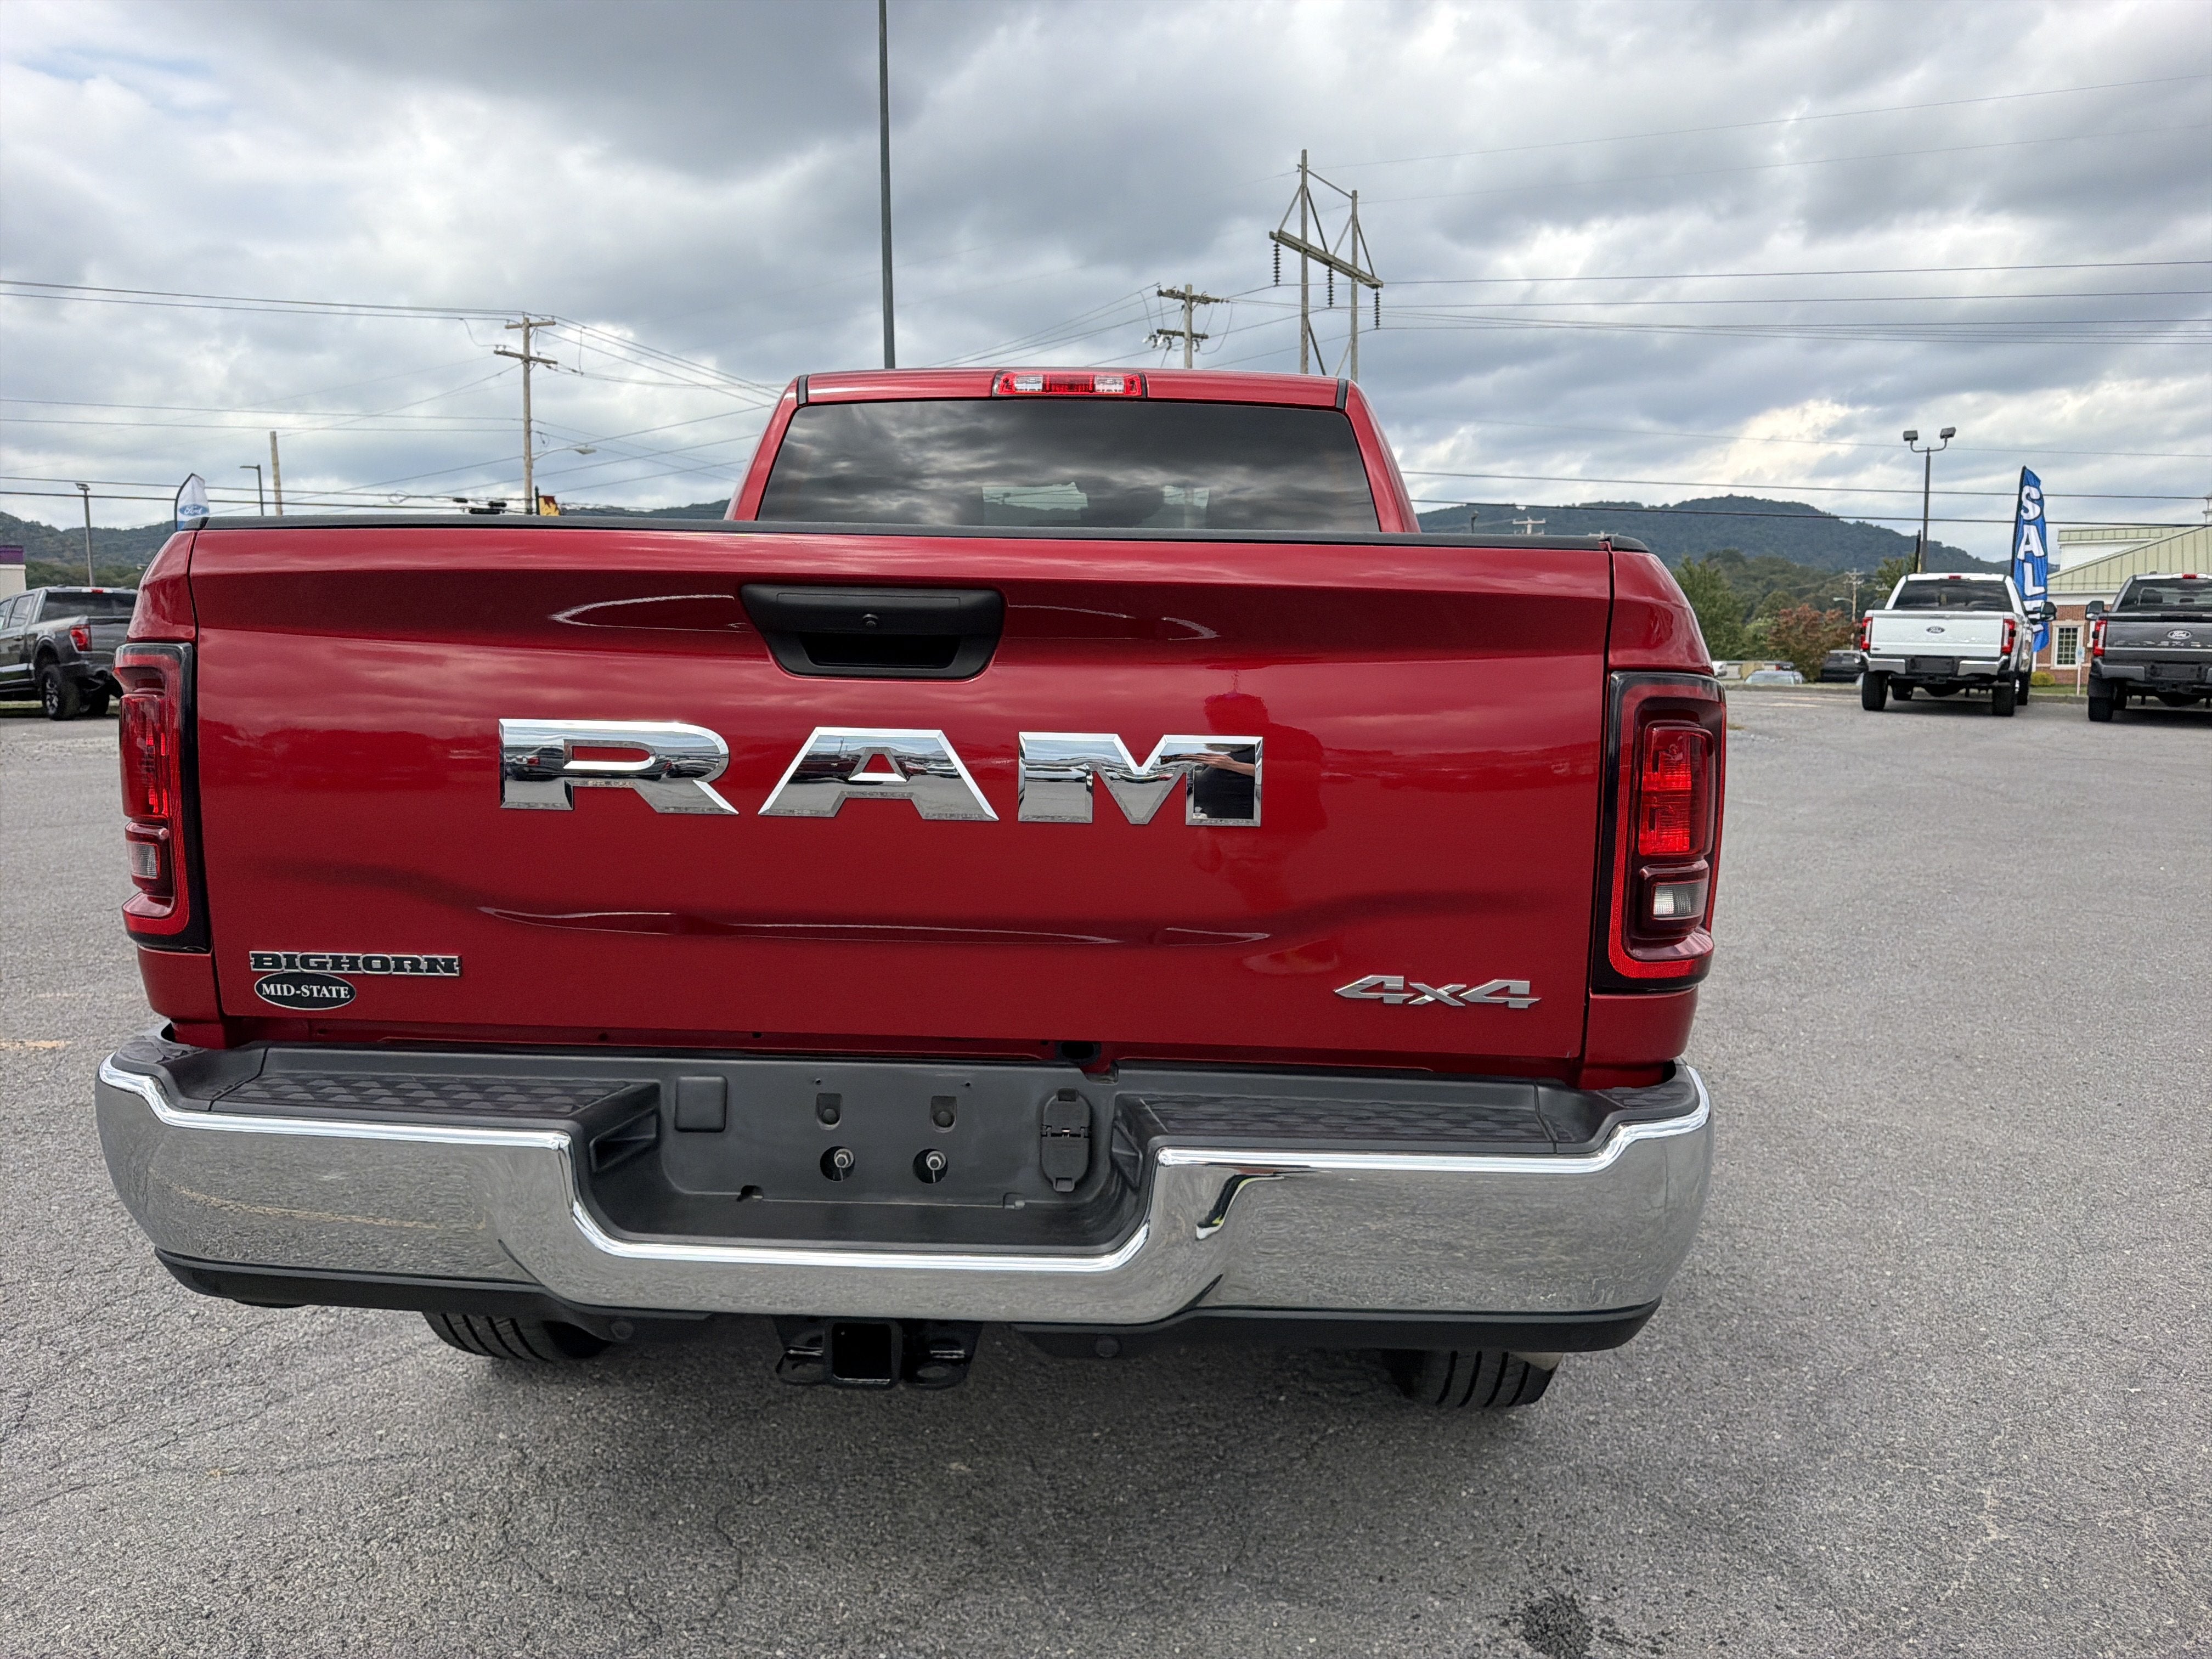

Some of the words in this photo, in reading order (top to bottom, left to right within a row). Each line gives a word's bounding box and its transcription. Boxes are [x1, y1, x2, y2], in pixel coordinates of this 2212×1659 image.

[499, 718, 1263, 827] RAM
[249, 950, 462, 977] BIGHORN
[261, 983, 351, 1000] MID-STATE
